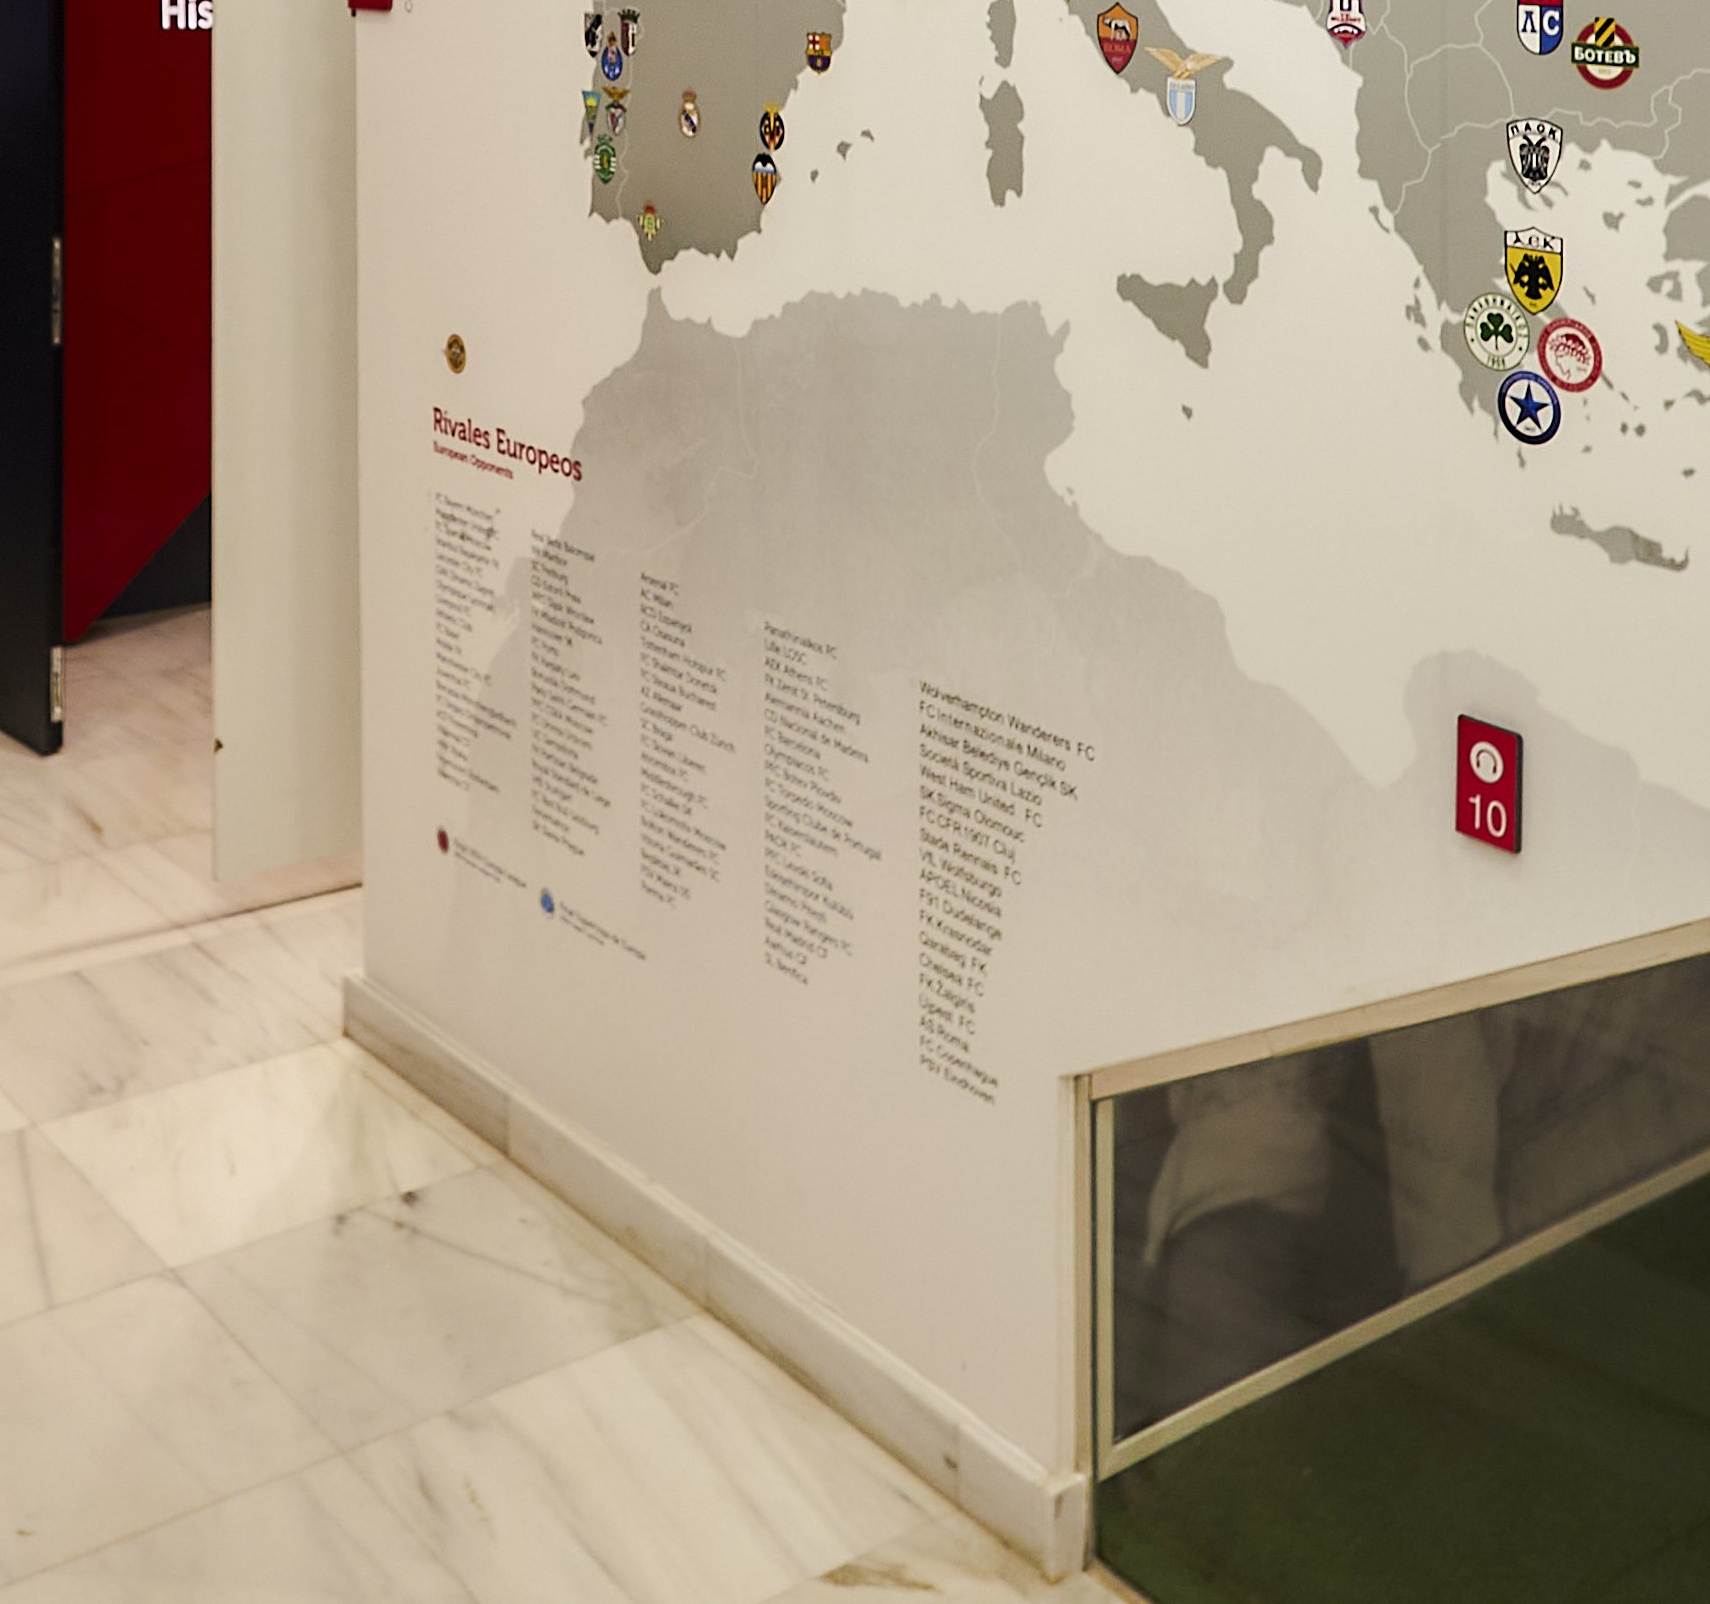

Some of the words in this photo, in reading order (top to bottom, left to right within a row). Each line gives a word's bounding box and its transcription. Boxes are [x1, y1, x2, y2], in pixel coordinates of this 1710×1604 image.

[433, 407, 490, 449] Rivales
[496, 427, 583, 482] Europeos
[433, 440, 468, 463] European
[470, 454, 514, 480] Opponents
[1007, 714, 1071, 751] Wanderers
[1026, 742, 1066, 771] Milano
[919, 763, 946, 786] West
[978, 788, 1014, 816] United
[1468, 794, 1507, 838] 10
